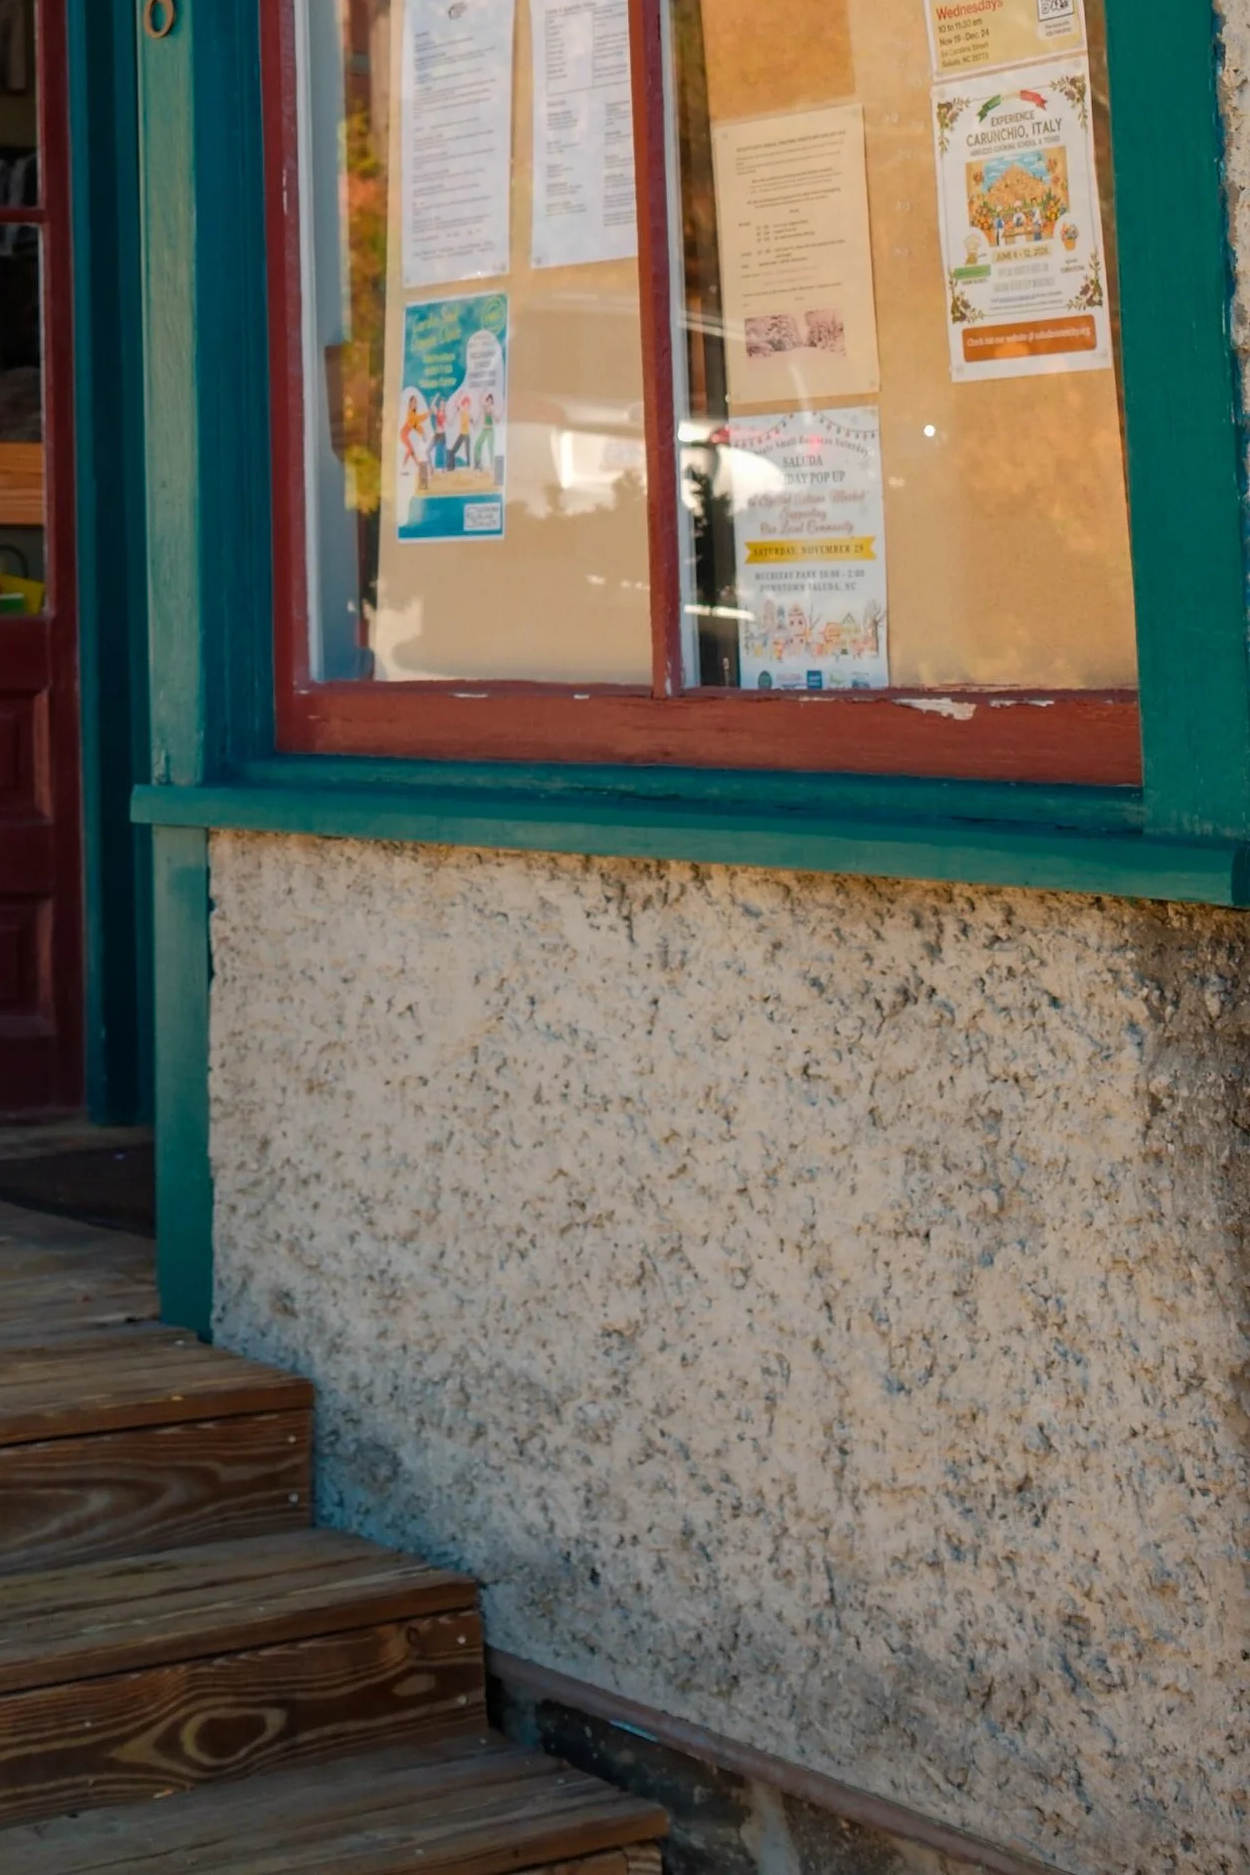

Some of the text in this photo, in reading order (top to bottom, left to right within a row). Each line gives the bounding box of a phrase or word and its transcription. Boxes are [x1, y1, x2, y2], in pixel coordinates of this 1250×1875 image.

[991, 110, 1035, 127] EXPERIENCE
[966, 117, 1062, 147] CARUNCHIO, ITALY
[783, 453, 824, 468] SALUDA
[810, 471, 830, 484] POP
[831, 470, 846, 483] UP
